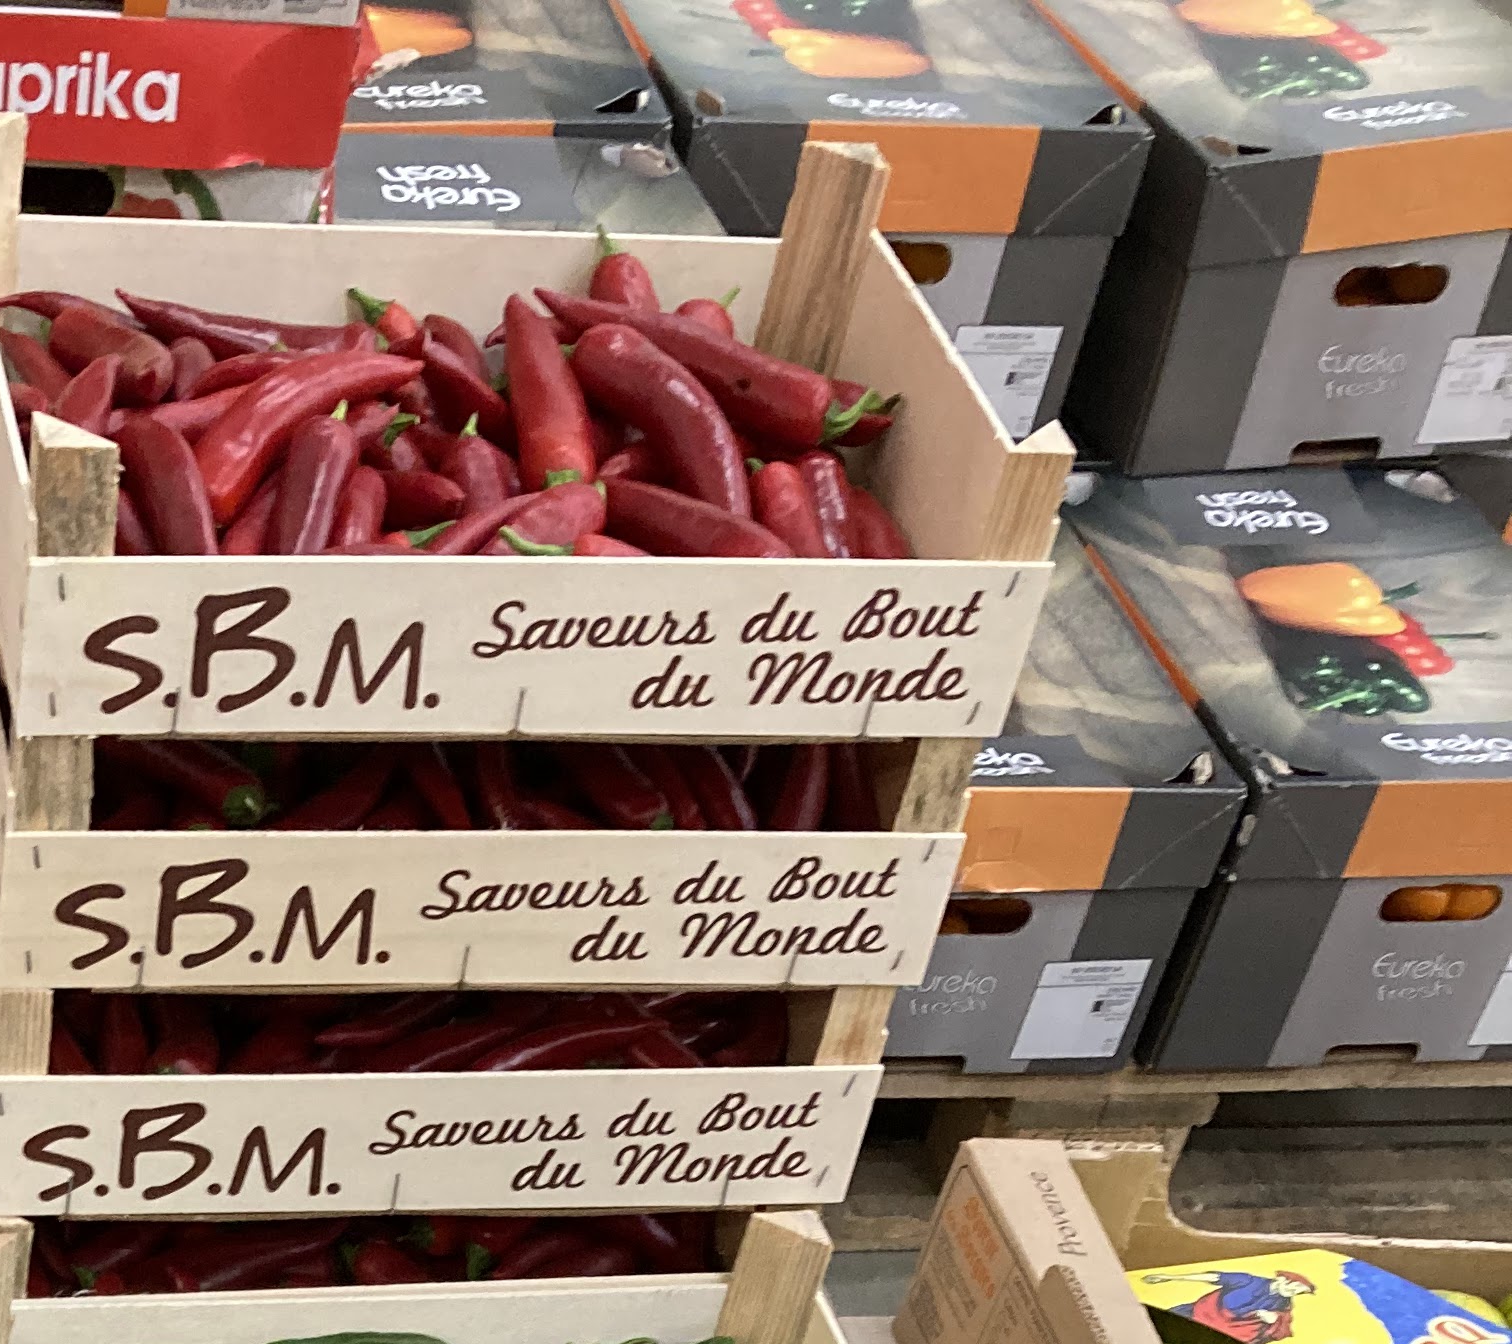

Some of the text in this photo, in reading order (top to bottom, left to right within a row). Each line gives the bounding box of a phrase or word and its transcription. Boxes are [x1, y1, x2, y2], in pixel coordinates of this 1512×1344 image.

[381, 182, 521, 212] Eureka
[83, 585, 439, 713] S.B.M.
[472, 587, 986, 658] Saveurs du Bout
[631, 647, 969, 709] du Monde
[54, 857, 390, 969] S.B.M.
[419, 856, 900, 919] Saveurs du Bout
[571, 908, 888, 961] du Monde
[1372, 952, 1466, 980] Eureka
[21, 1102, 340, 1201] S.B.M.
[368, 1091, 820, 1154] Saveurs du Bout
[512, 1137, 810, 1191] du Monde
